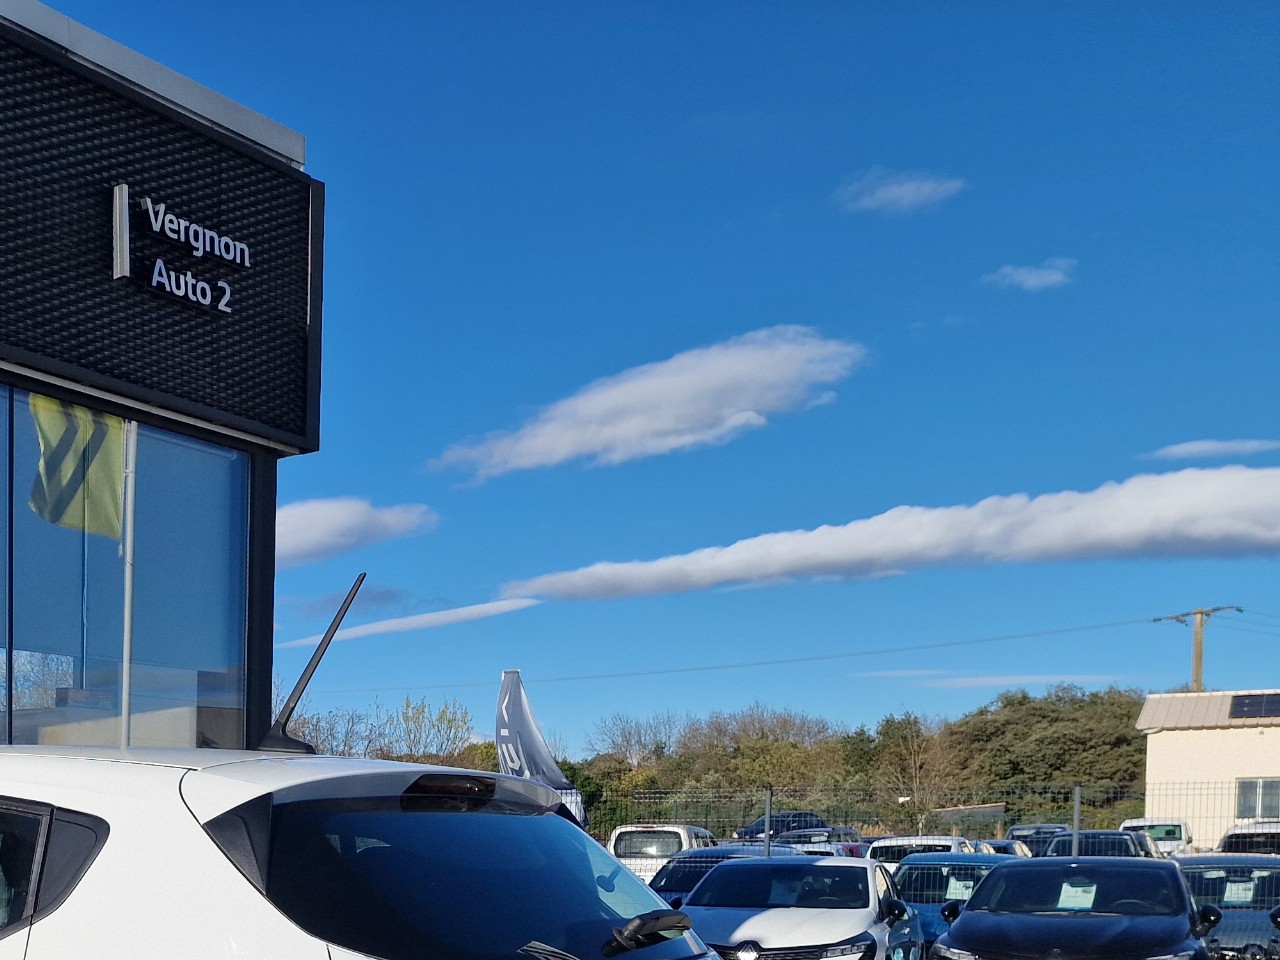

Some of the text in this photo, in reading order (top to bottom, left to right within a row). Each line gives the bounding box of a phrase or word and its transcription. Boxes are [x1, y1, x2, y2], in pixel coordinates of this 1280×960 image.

[144, 197, 250, 267] Vergnon
[152, 259, 232, 313] Auto 2
